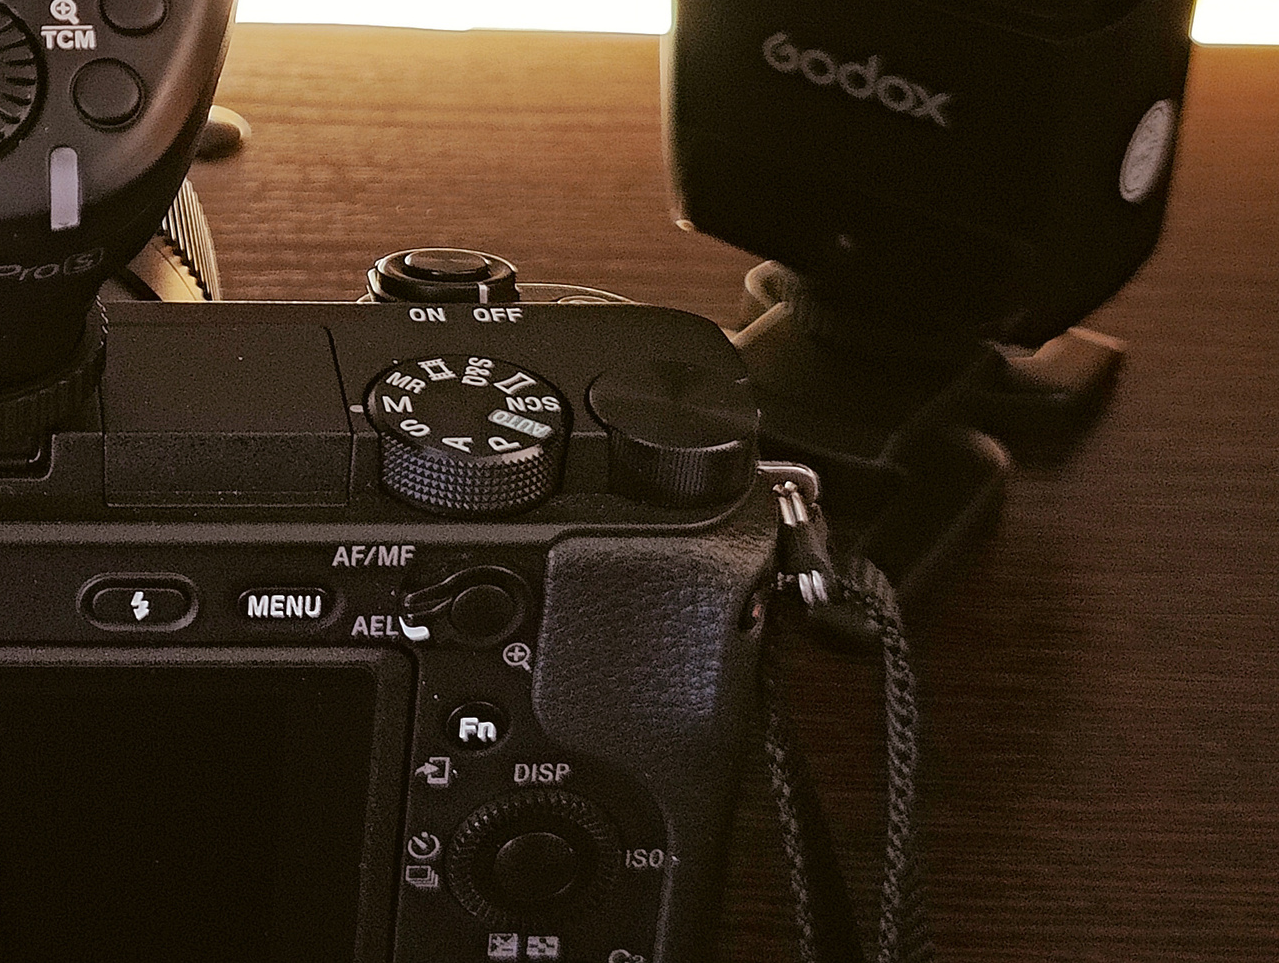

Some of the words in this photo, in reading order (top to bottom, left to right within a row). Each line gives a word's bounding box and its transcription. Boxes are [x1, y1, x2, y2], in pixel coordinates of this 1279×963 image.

[43, 30, 96, 50] TCM
[761, 32, 952, 128] Godox
[408, 307, 447, 323] ON
[472, 307, 523, 323] OFF
[385, 371, 427, 394] MR
[381, 395, 414, 414] M
[505, 395, 562, 413] SCN
[399, 418, 431, 438] S
[489, 410, 552, 438] AUTO
[441, 436, 474, 454] A
[487, 436, 522, 453] P
[331, 544, 415, 568] AF/MF
[246, 595, 323, 619] MENU
[350, 615, 399, 638] AEL
[457, 717, 497, 743] Fn
[512, 762, 571, 784] DISP
[625, 849, 665, 870] ISO
